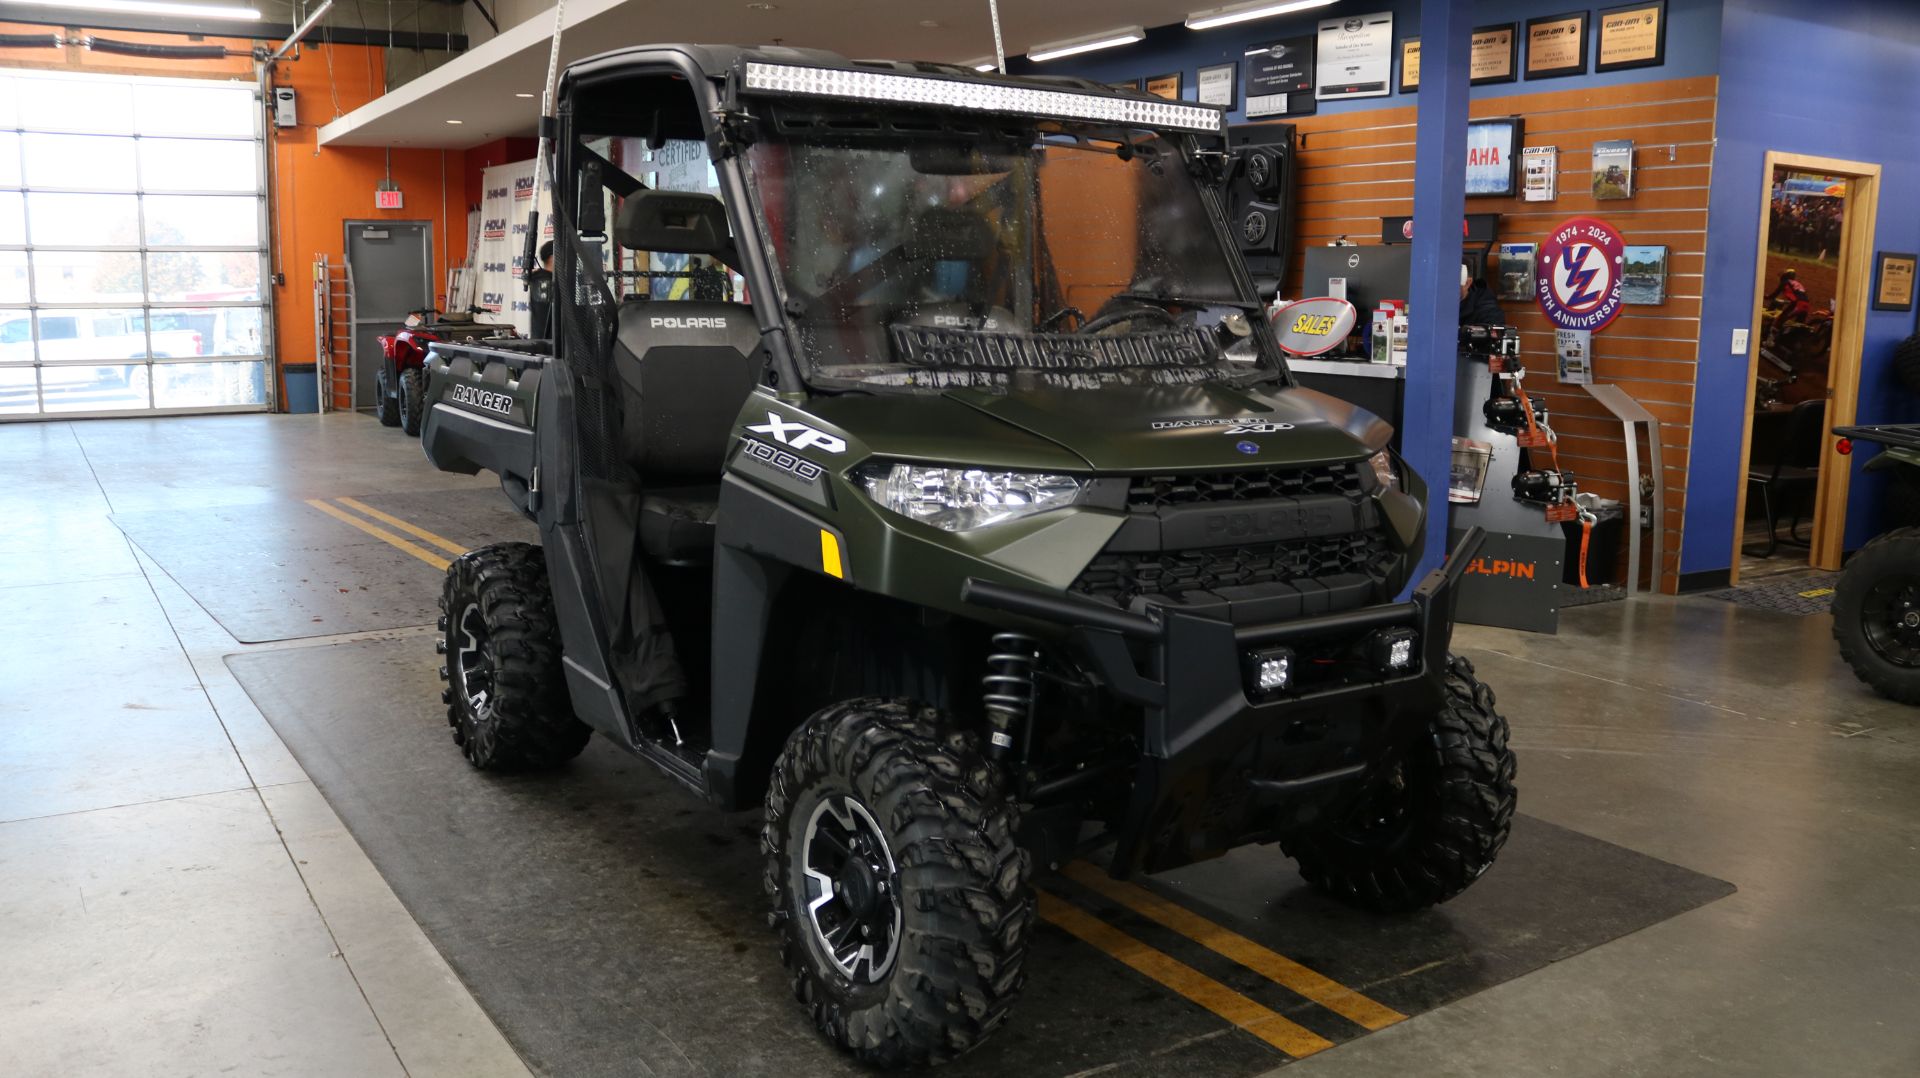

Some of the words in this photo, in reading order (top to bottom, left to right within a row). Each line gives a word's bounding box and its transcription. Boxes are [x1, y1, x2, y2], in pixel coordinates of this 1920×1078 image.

[659, 141, 701, 166] CERTIFIED
[1469, 147, 1500, 166] AHA
[381, 191, 399, 207] EXIT
[1555, 225, 1578, 245] 1974
[1588, 225, 1612, 246] 2024
[1539, 278, 1555, 311] 50TH
[1553, 279, 1622, 328] ANNIVERSARY
[650, 317, 727, 328] POLARIS
[1292, 313, 1336, 336] SALES
[1557, 331, 1576, 339] FRESH
[452, 384, 512, 414] RANGER
[745, 411, 847, 453] XP
[1152, 418, 1268, 430] RANGER
[1224, 422, 1295, 434] XP
[744, 439, 821, 480] 1000
[1206, 506, 1332, 538] POLARIS
[1465, 559, 1535, 579] LPIN
